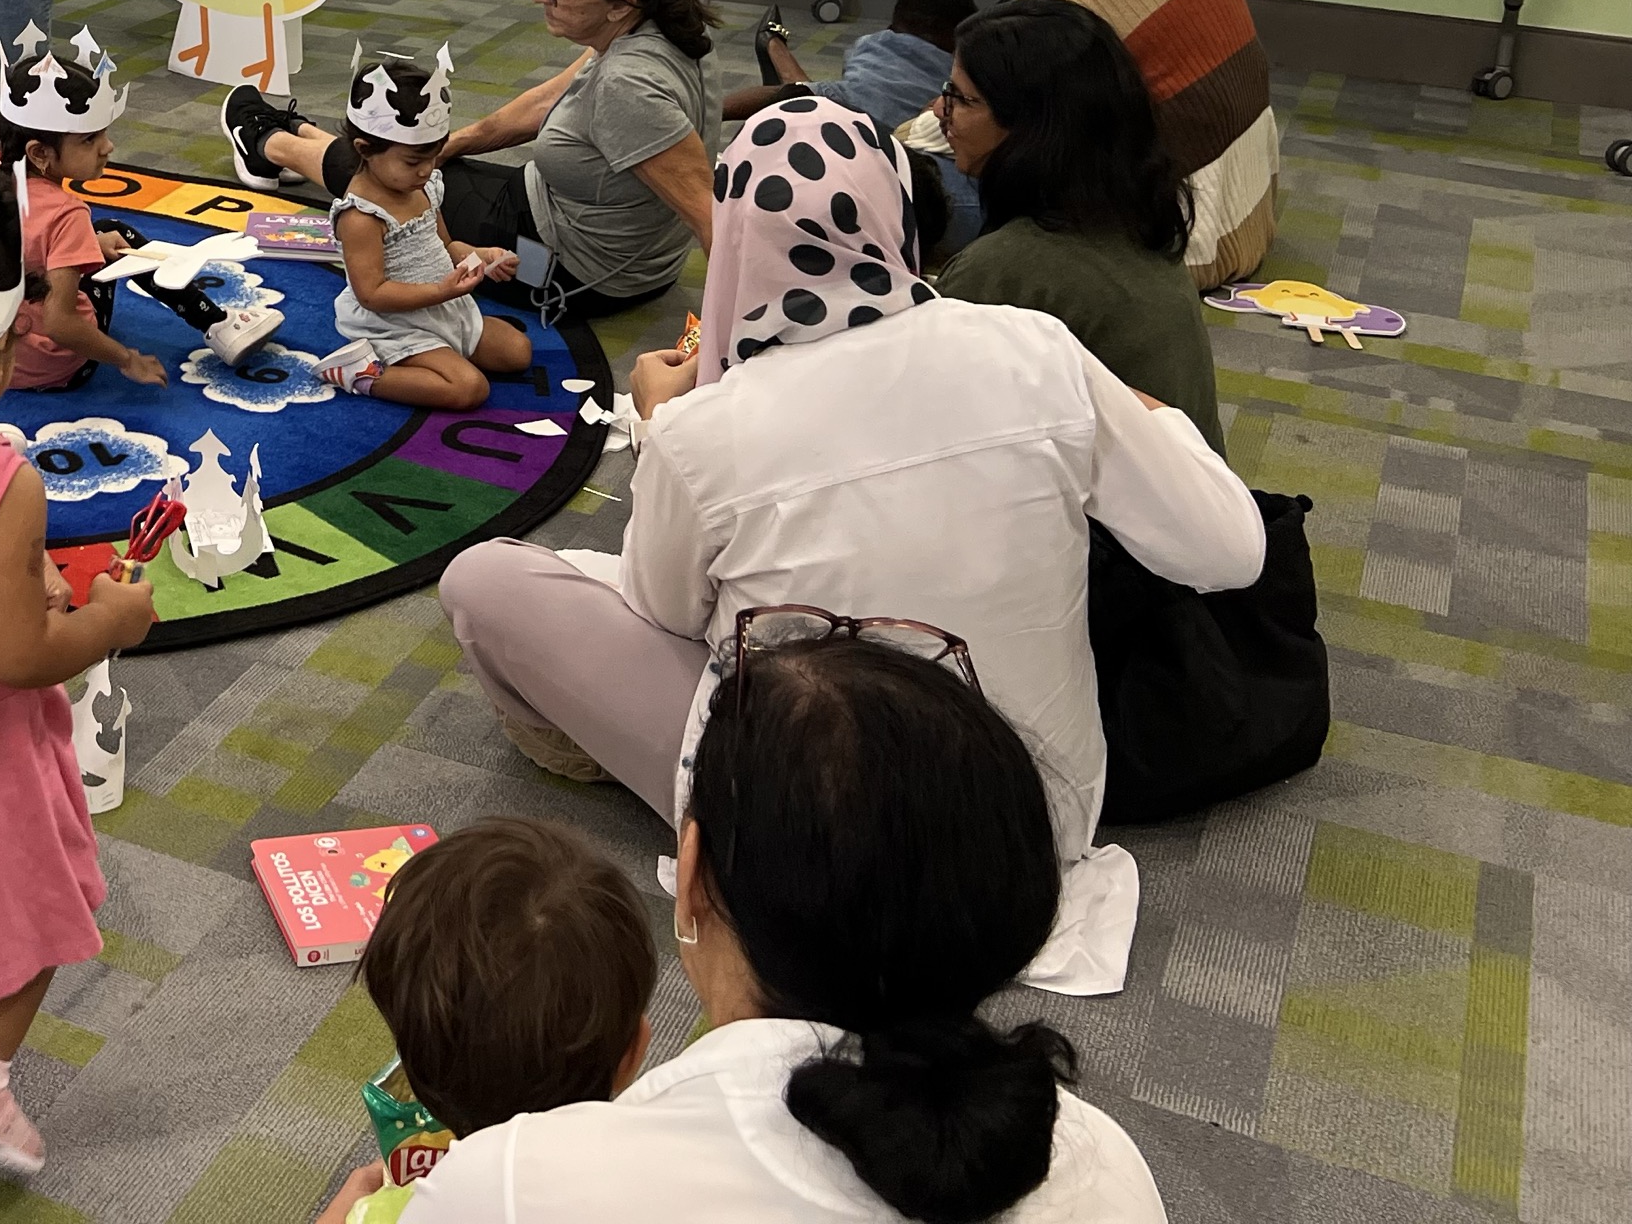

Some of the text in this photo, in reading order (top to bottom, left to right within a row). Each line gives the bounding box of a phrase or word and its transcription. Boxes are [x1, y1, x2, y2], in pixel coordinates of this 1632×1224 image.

[185, 195, 254, 217] P
[270, 852, 322, 931] LOS POLLITOS
[297, 870, 329, 906] DICEN
